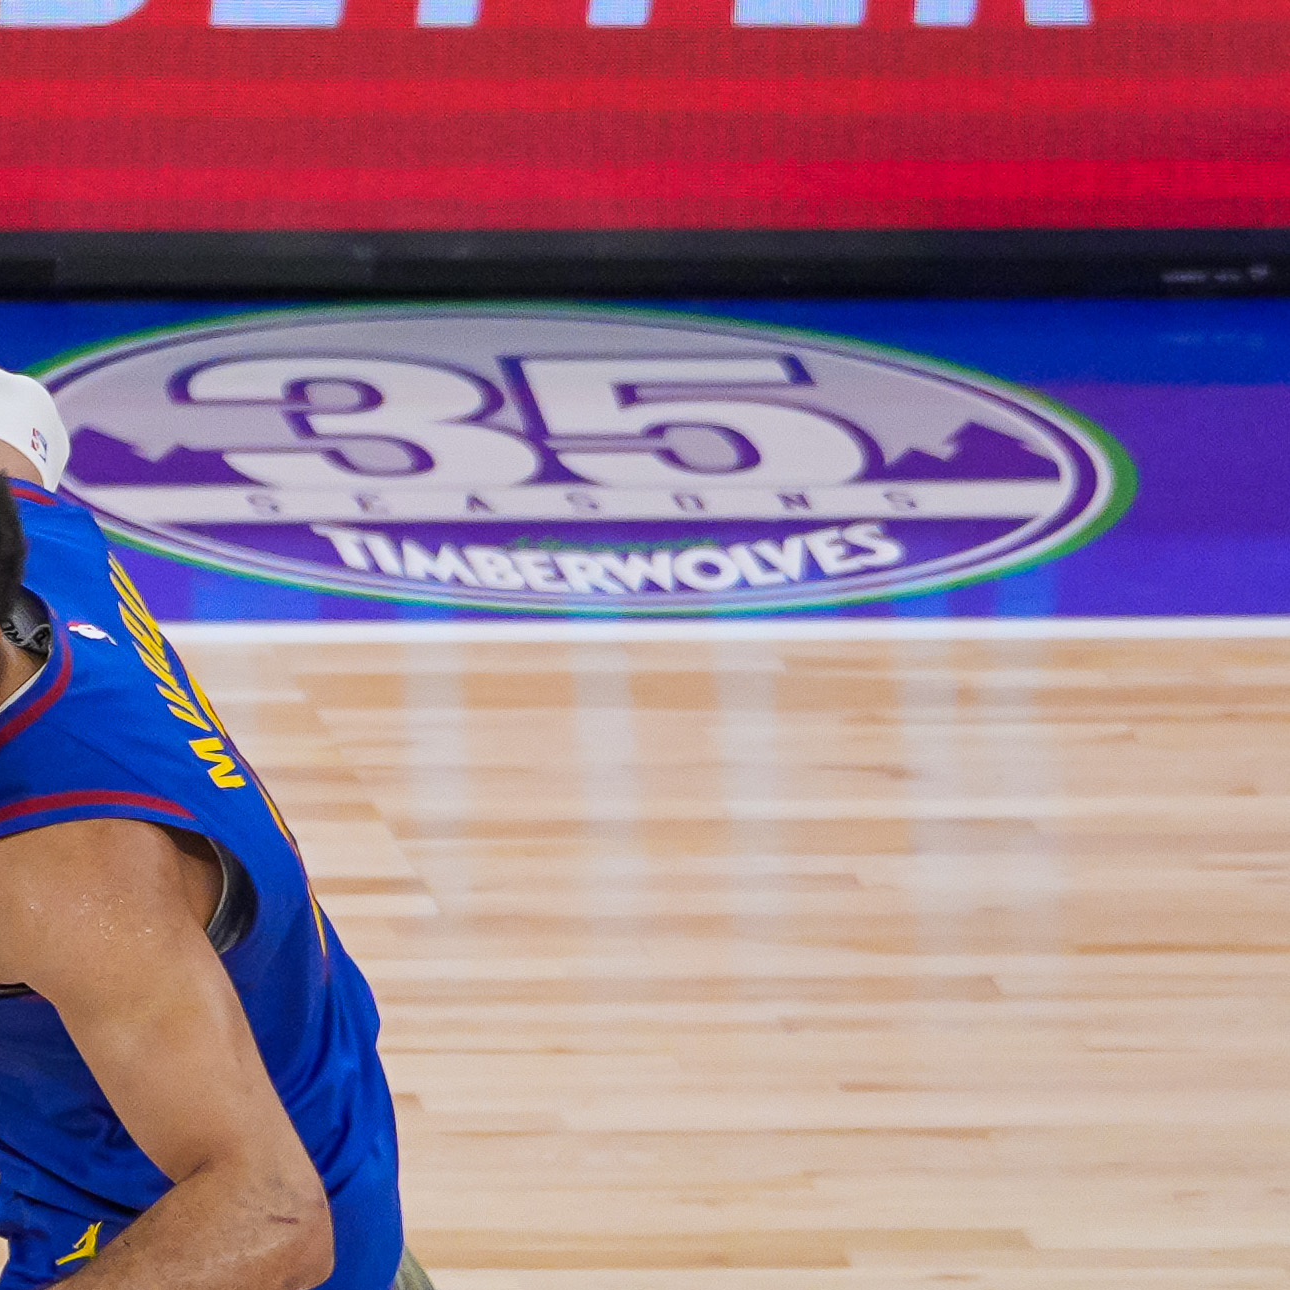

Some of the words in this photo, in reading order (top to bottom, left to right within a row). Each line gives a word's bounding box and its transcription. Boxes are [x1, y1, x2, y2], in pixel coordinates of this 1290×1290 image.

[169, 354, 881, 484] 35
[247, 490, 917, 514] SEASONS
[313, 522, 905, 594] TIMBERWOLVES
